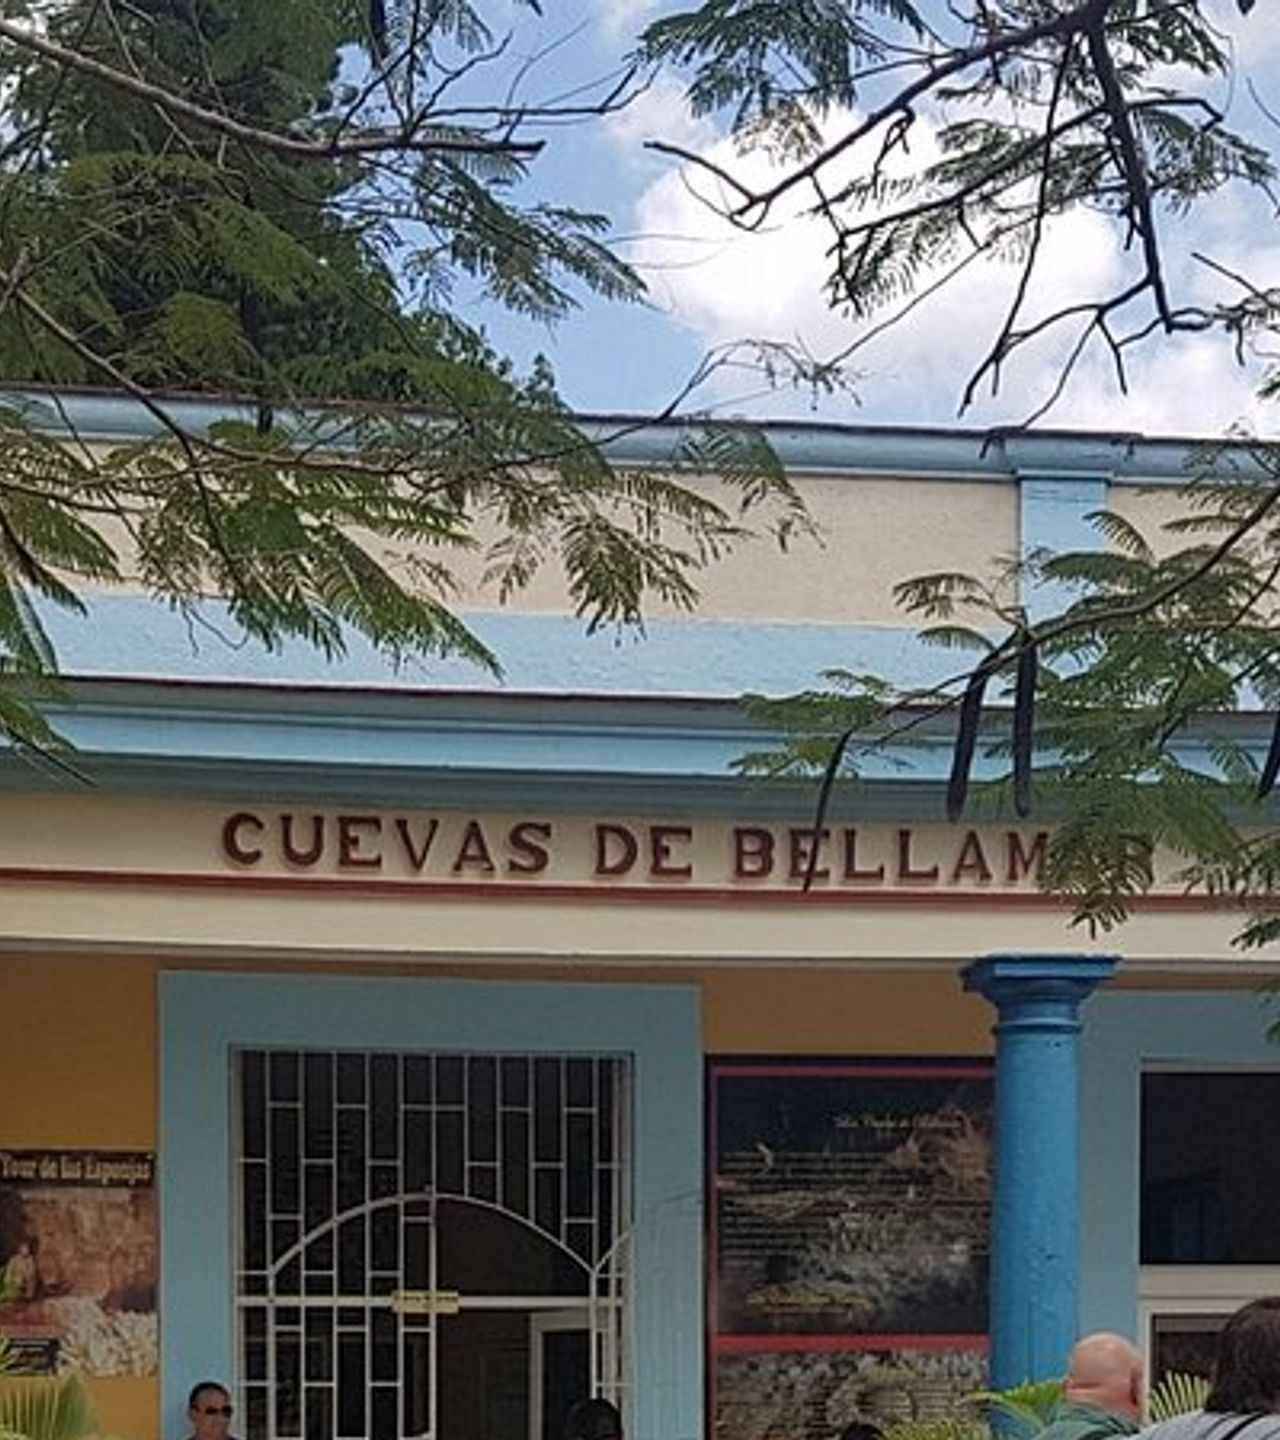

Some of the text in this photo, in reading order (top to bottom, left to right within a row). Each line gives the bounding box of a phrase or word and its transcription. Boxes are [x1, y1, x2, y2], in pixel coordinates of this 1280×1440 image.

[222, 810, 1154, 884] CUEVAS DE BELLAMR
